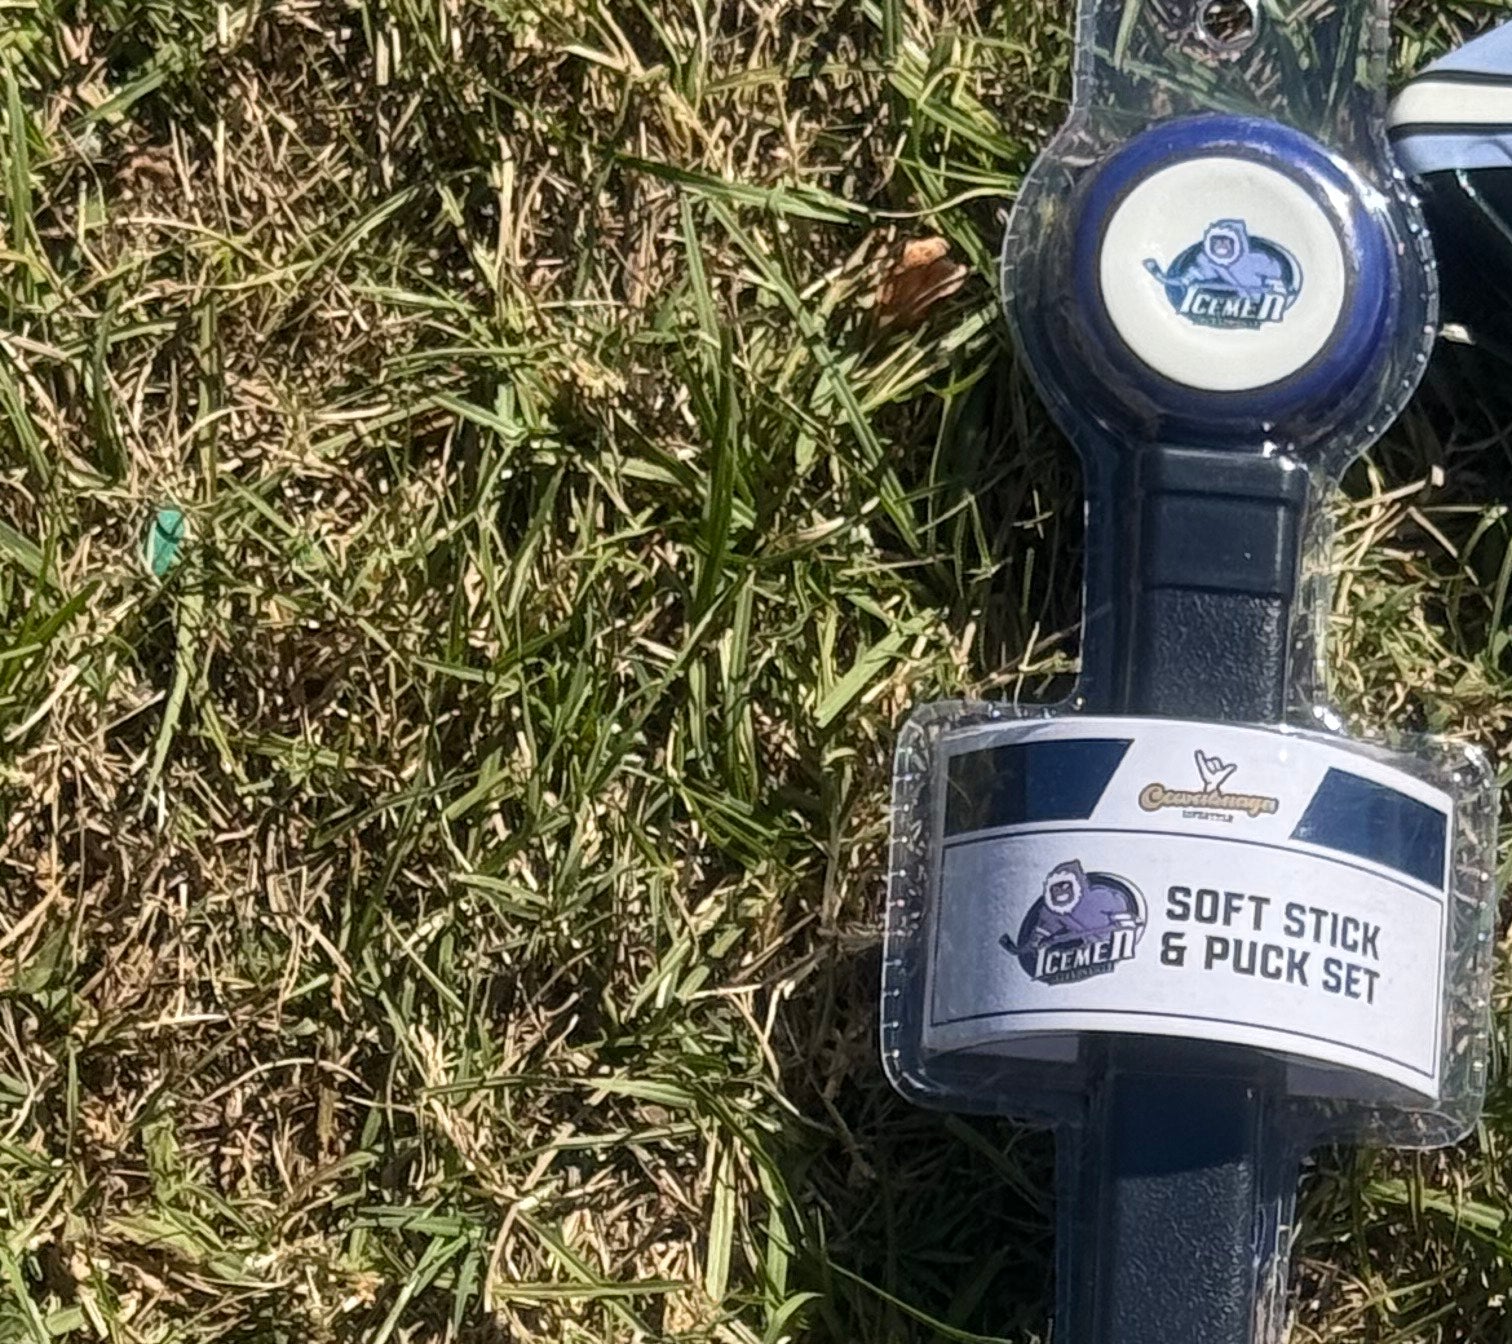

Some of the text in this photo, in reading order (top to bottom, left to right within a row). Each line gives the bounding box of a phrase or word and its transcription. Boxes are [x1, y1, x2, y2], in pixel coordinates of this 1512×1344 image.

[1166, 886, 1380, 961] SOFT STICK
[1160, 932, 1380, 1005] & PUCK SET
